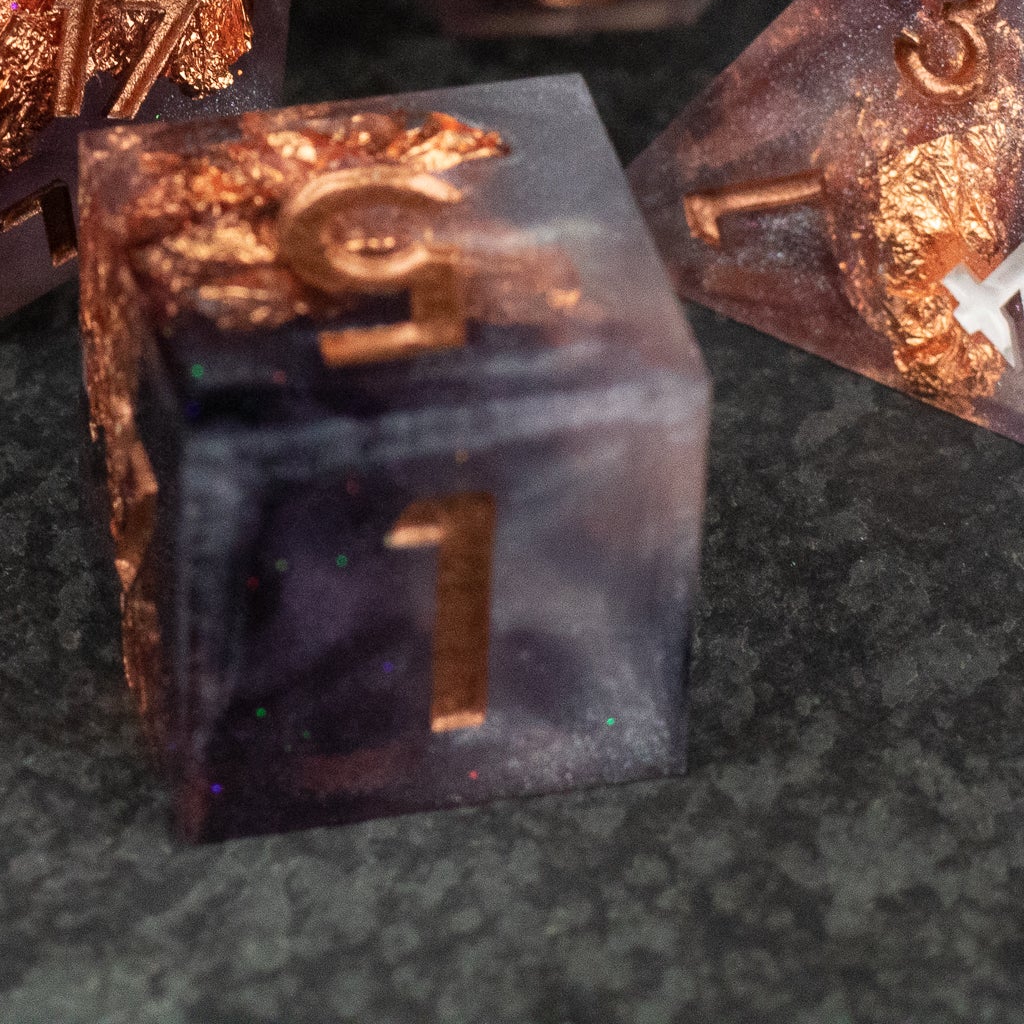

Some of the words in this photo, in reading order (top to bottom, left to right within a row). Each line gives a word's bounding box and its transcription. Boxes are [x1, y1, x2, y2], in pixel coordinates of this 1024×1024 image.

[284, 166, 467, 367] 5
[683, 176, 828, 248] 1
[384, 490, 496, 733] 1
